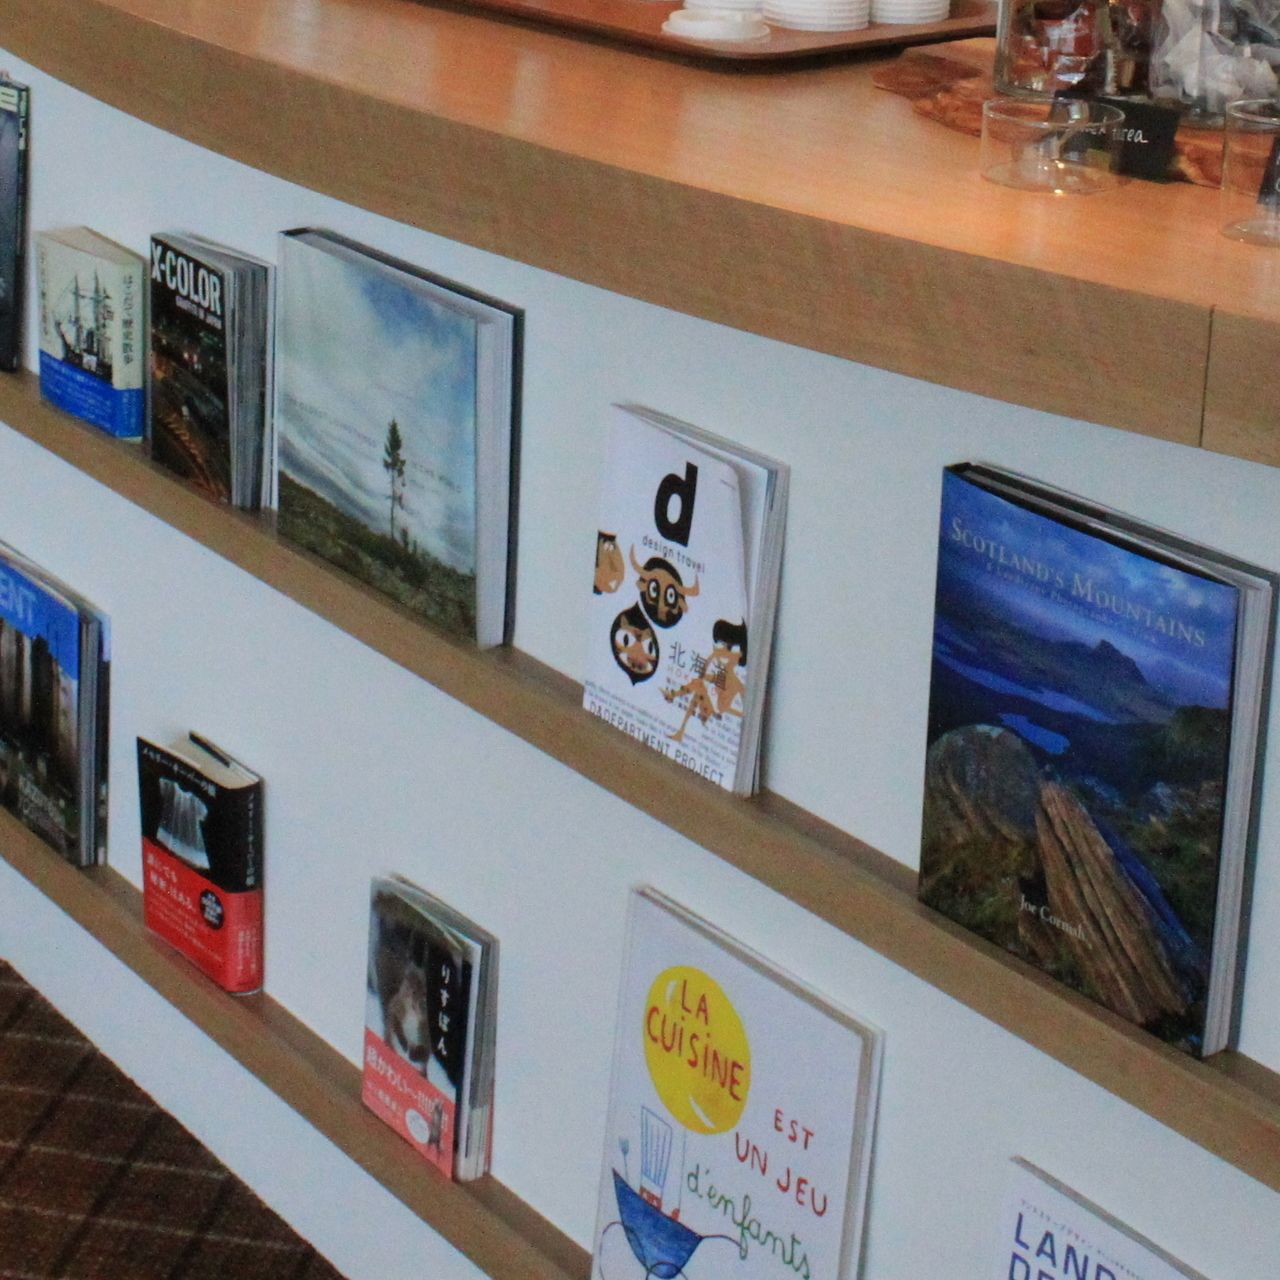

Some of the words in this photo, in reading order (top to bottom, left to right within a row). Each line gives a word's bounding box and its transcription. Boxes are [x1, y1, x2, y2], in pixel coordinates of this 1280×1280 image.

[151, 240, 221, 317] X-COLOR
[655, 461, 698, 548] d
[642, 535, 674, 559] design
[676, 549, 705, 573] travel
[1071, 571, 1206, 648] MOUNTAINS
[674, 747, 725, 786] PROJECT
[1019, 892, 1037, 915] Joe
[681, 980, 708, 1025] LA
[774, 1108, 814, 1151] EST
[735, 1131, 768, 1176] UN
[777, 1167, 828, 1217] JEU
[687, 1163, 811, 1280] d'enfants
